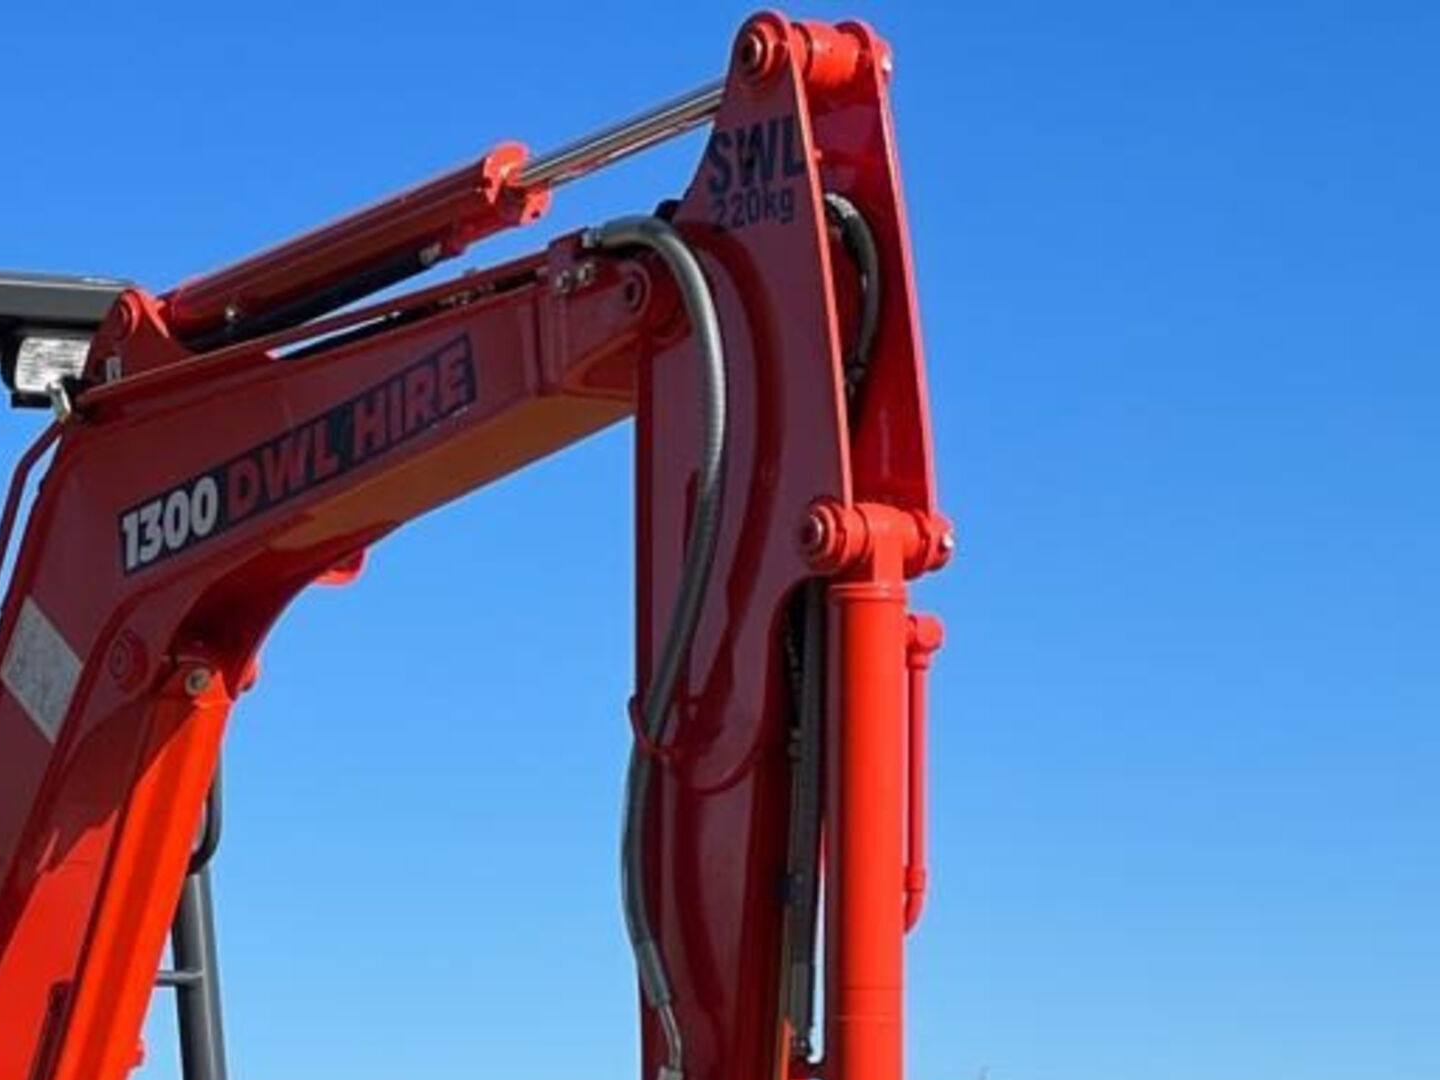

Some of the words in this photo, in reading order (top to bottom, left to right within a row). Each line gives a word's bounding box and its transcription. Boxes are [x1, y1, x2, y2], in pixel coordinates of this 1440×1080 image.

[707, 117, 805, 194] SWL
[123, 476, 218, 570] 1300
[227, 419, 338, 520] DWL
[351, 344, 469, 460] HIRE
